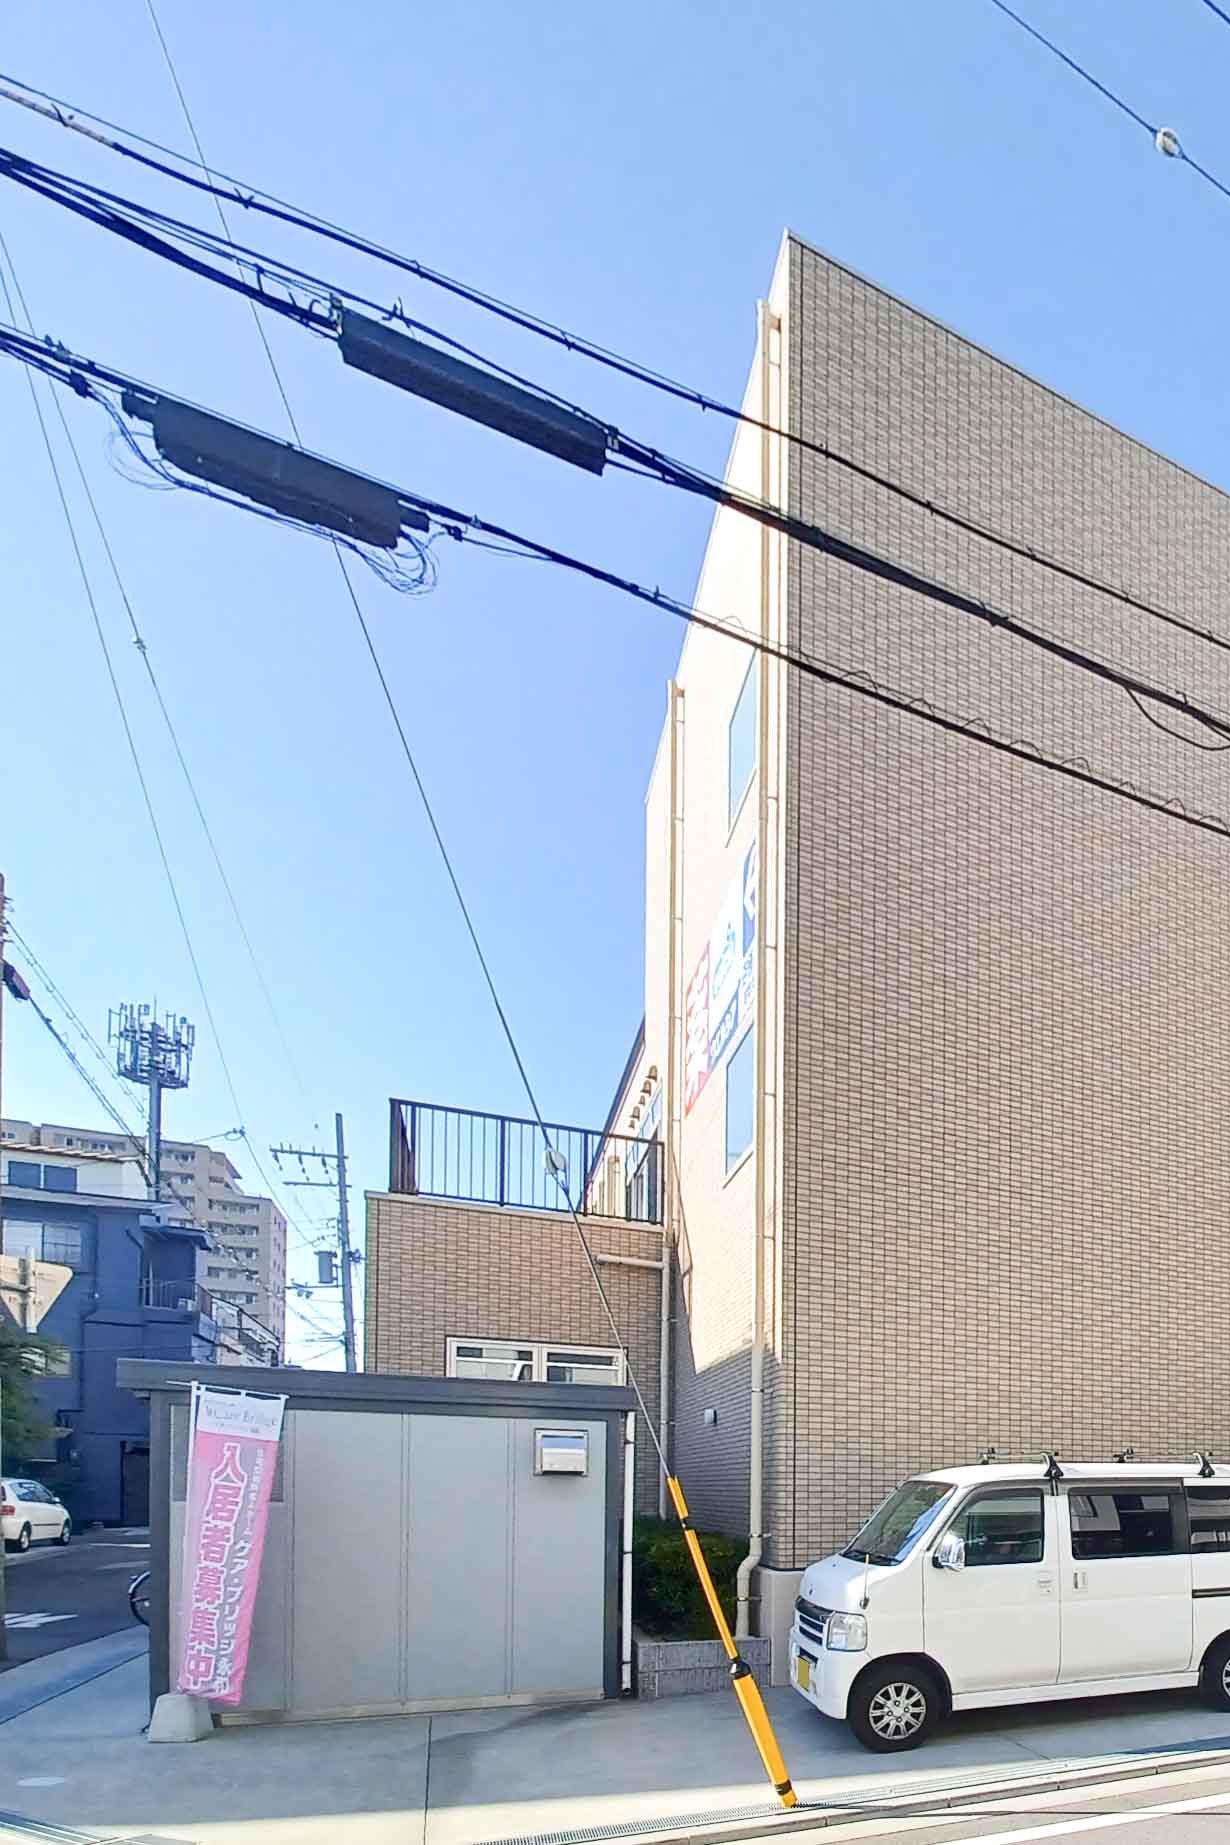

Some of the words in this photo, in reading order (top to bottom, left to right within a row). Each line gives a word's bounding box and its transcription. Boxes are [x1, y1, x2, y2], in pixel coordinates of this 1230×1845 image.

[184, 1441, 247, 1689] 入居者募集中
